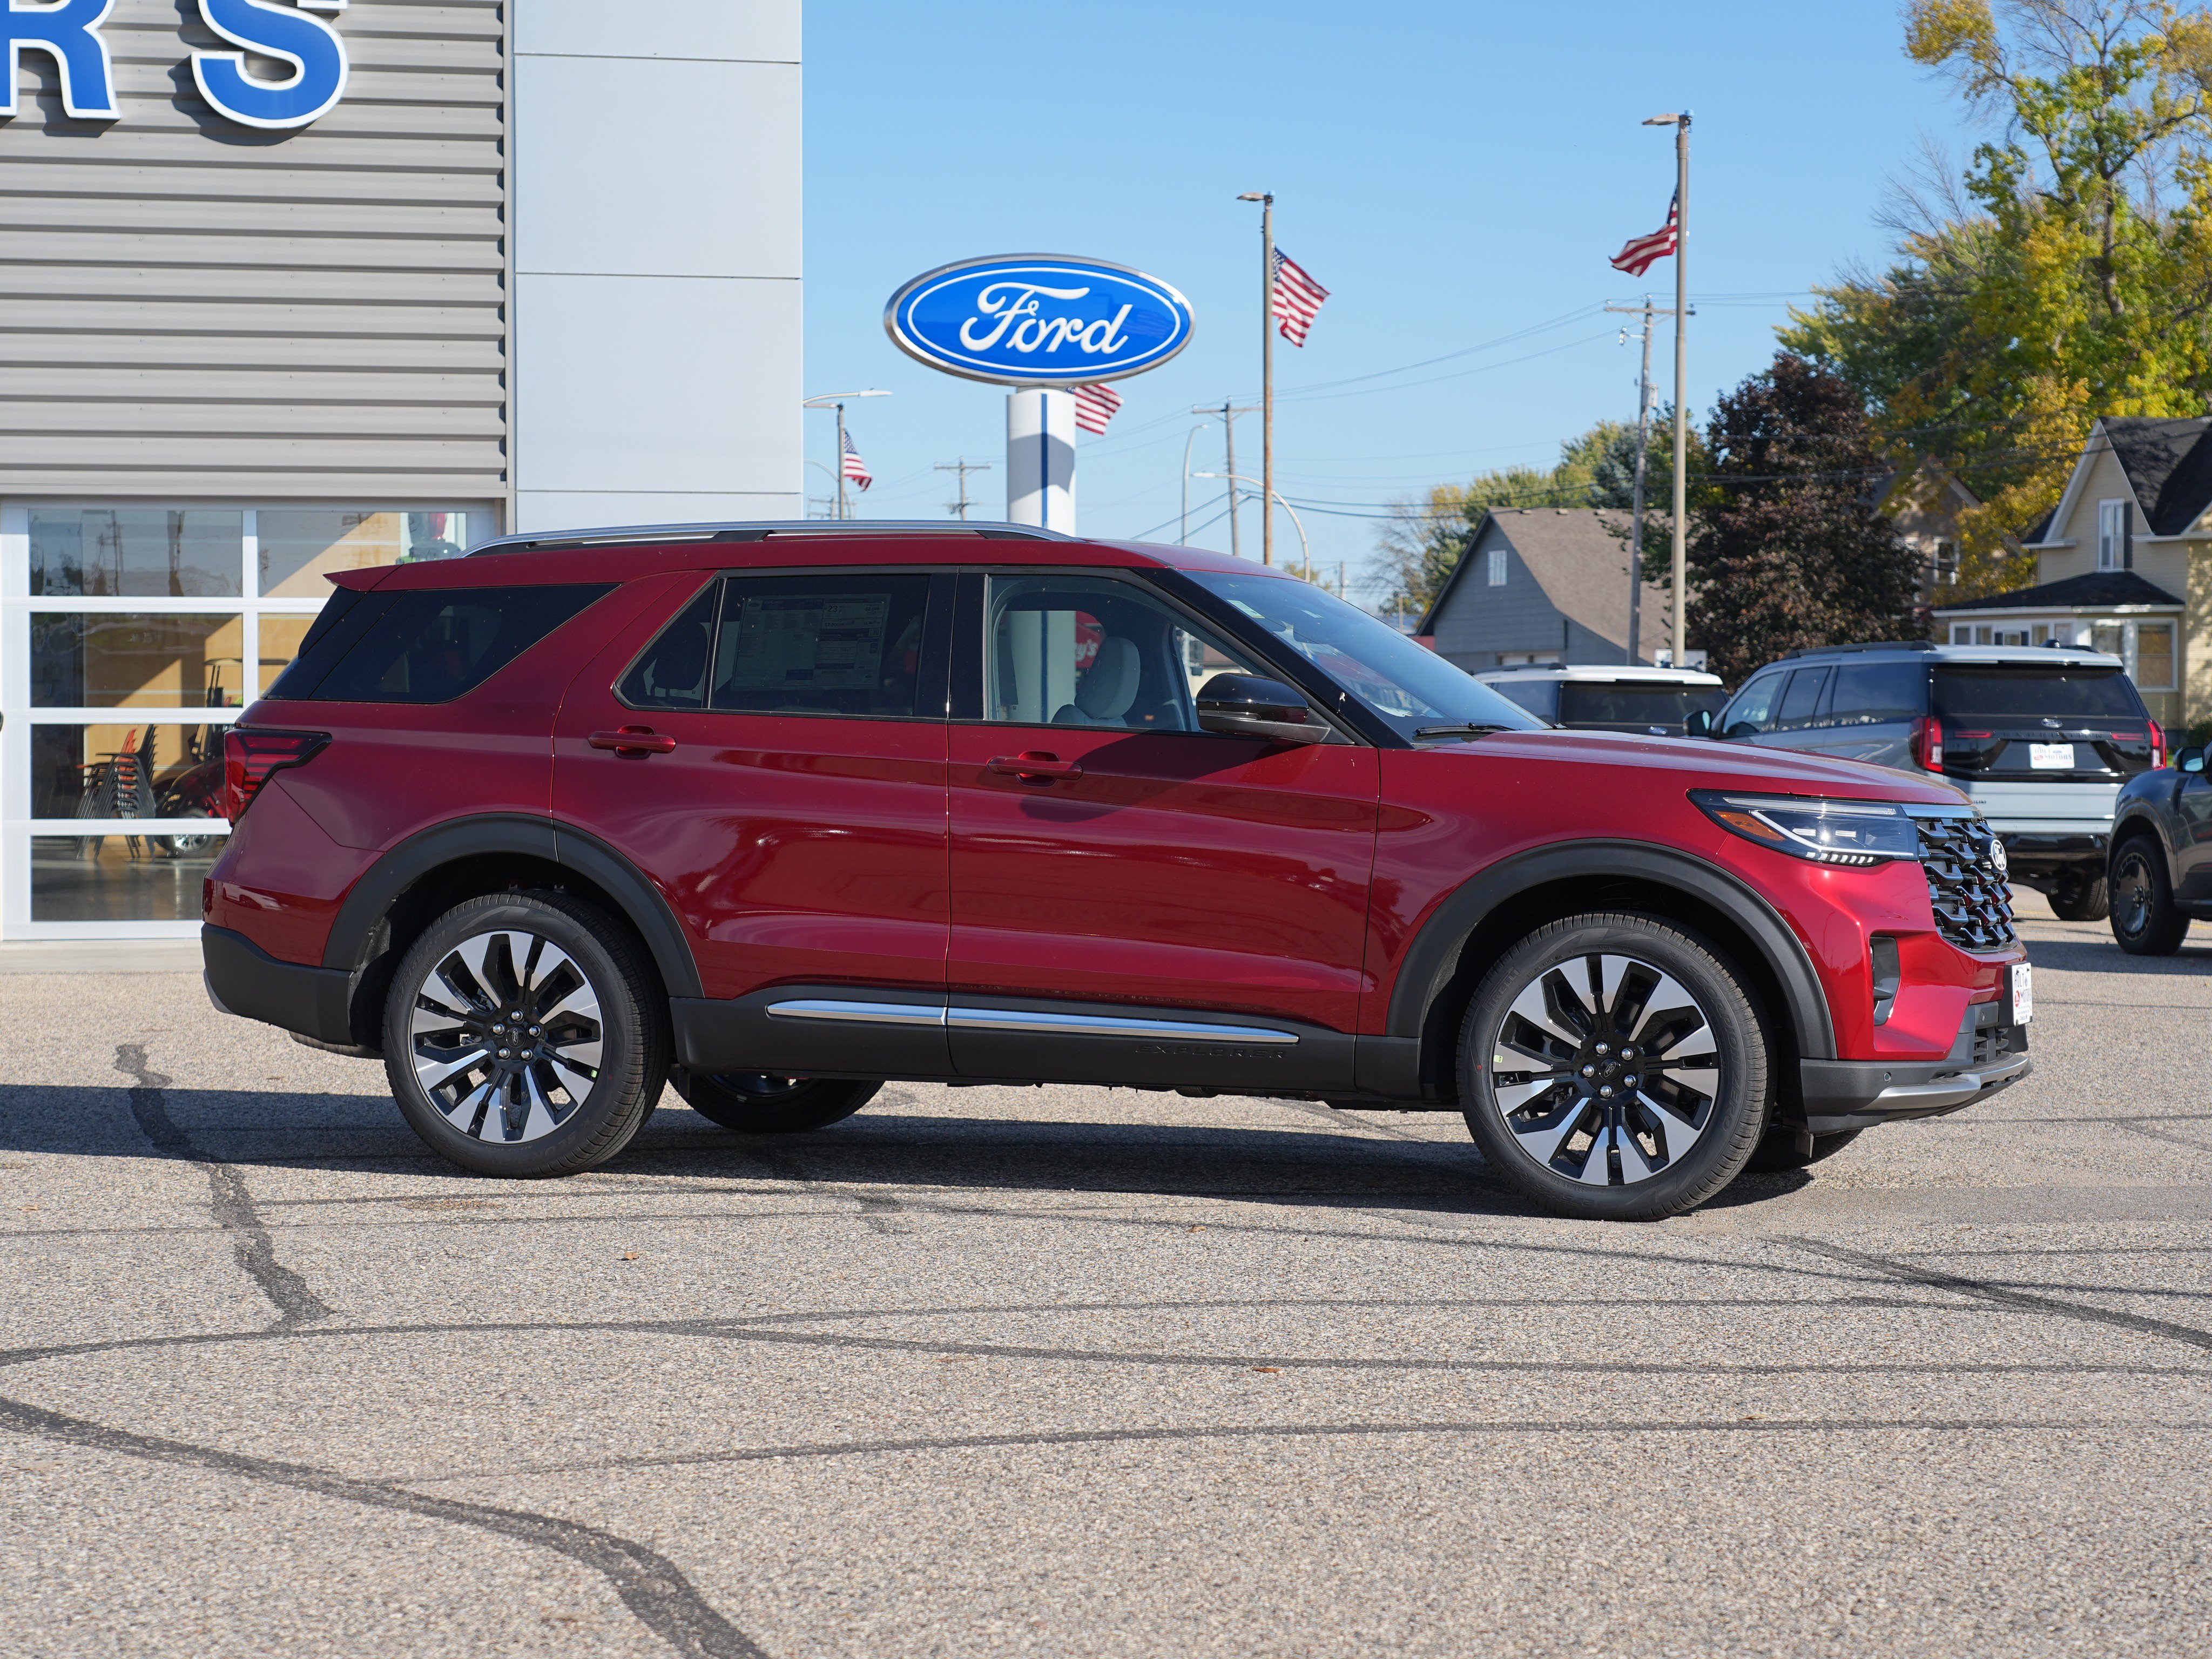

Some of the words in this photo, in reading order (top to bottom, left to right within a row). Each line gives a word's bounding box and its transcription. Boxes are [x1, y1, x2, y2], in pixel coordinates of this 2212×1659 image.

[959, 281, 1133, 354] Ford
[1481, 965, 1520, 1013] PIRELLI
[1684, 963, 1740, 1064] SCORPION
[1722, 1072, 1742, 1133] ZERO
